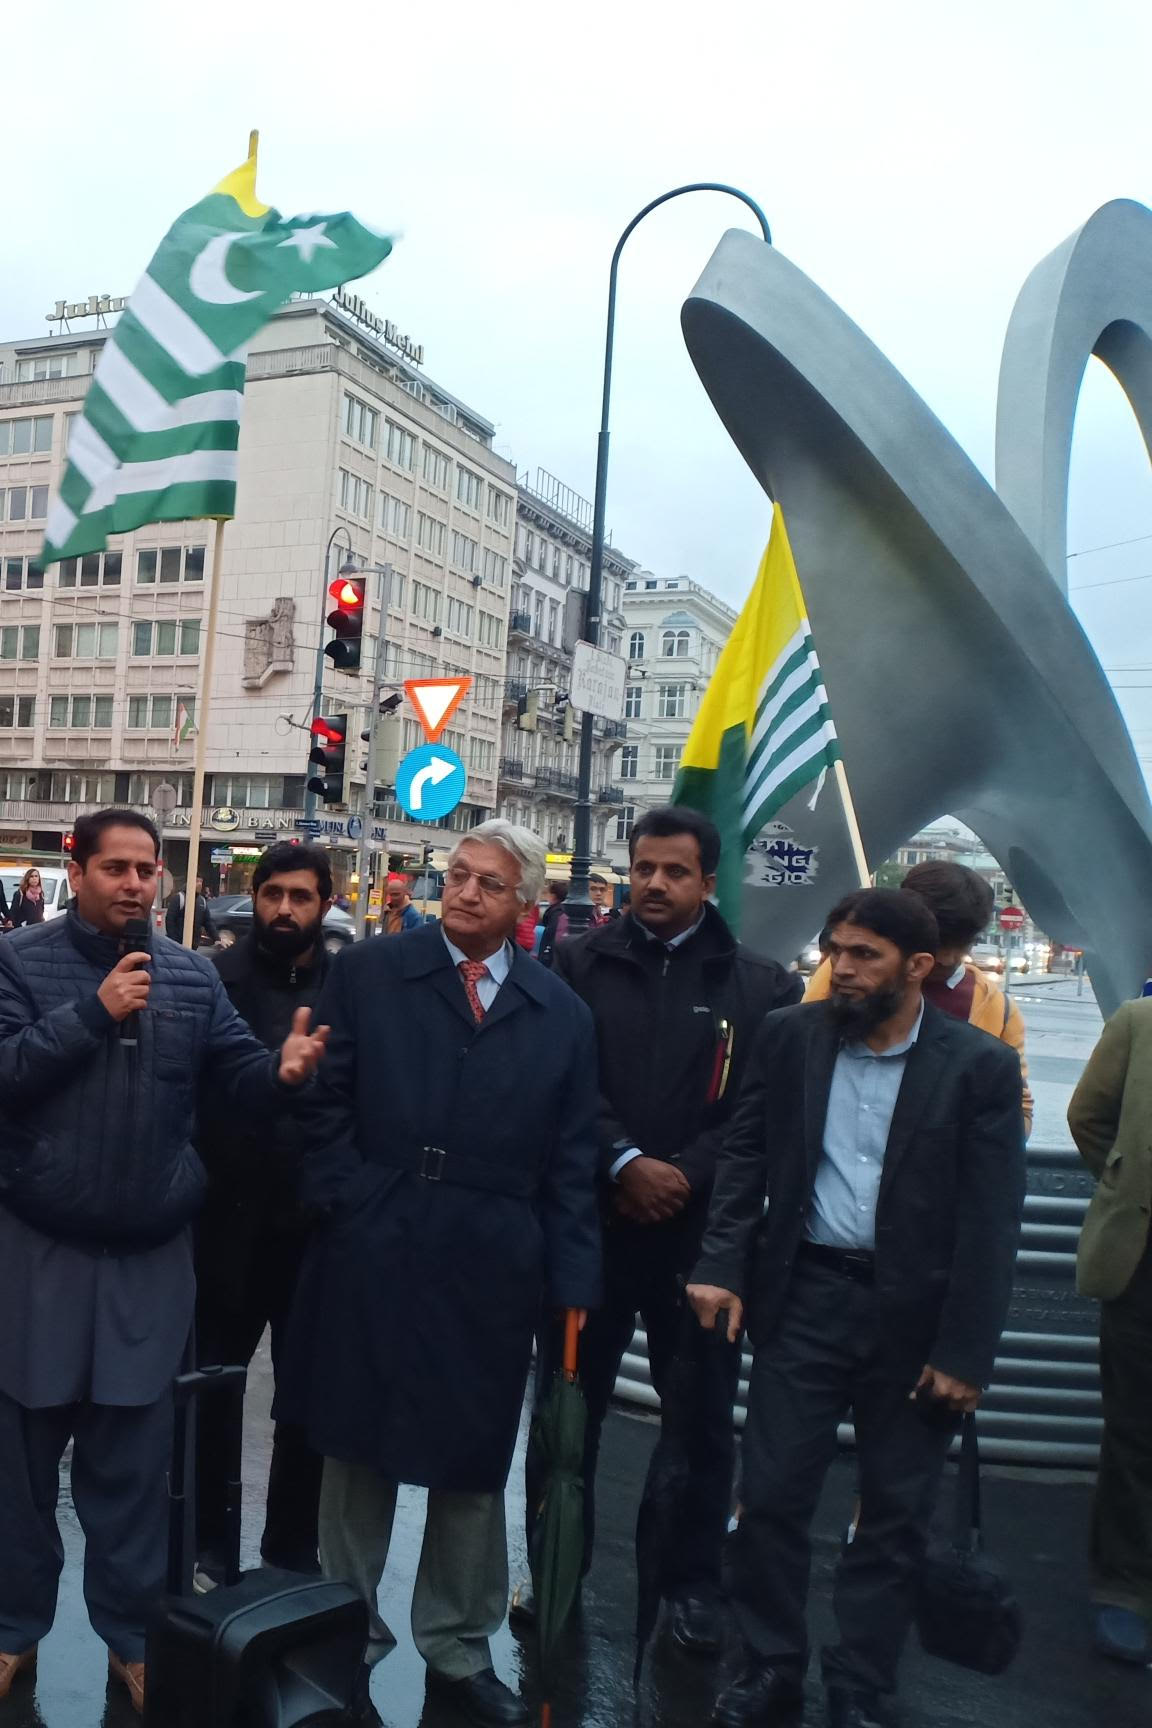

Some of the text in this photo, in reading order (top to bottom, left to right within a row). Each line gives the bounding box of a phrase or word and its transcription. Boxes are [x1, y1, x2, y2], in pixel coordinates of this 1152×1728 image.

[45, 293, 131, 321] Juliu
[332, 284, 425, 365] Julius Meinl
[248, 817, 289, 829] BAN
